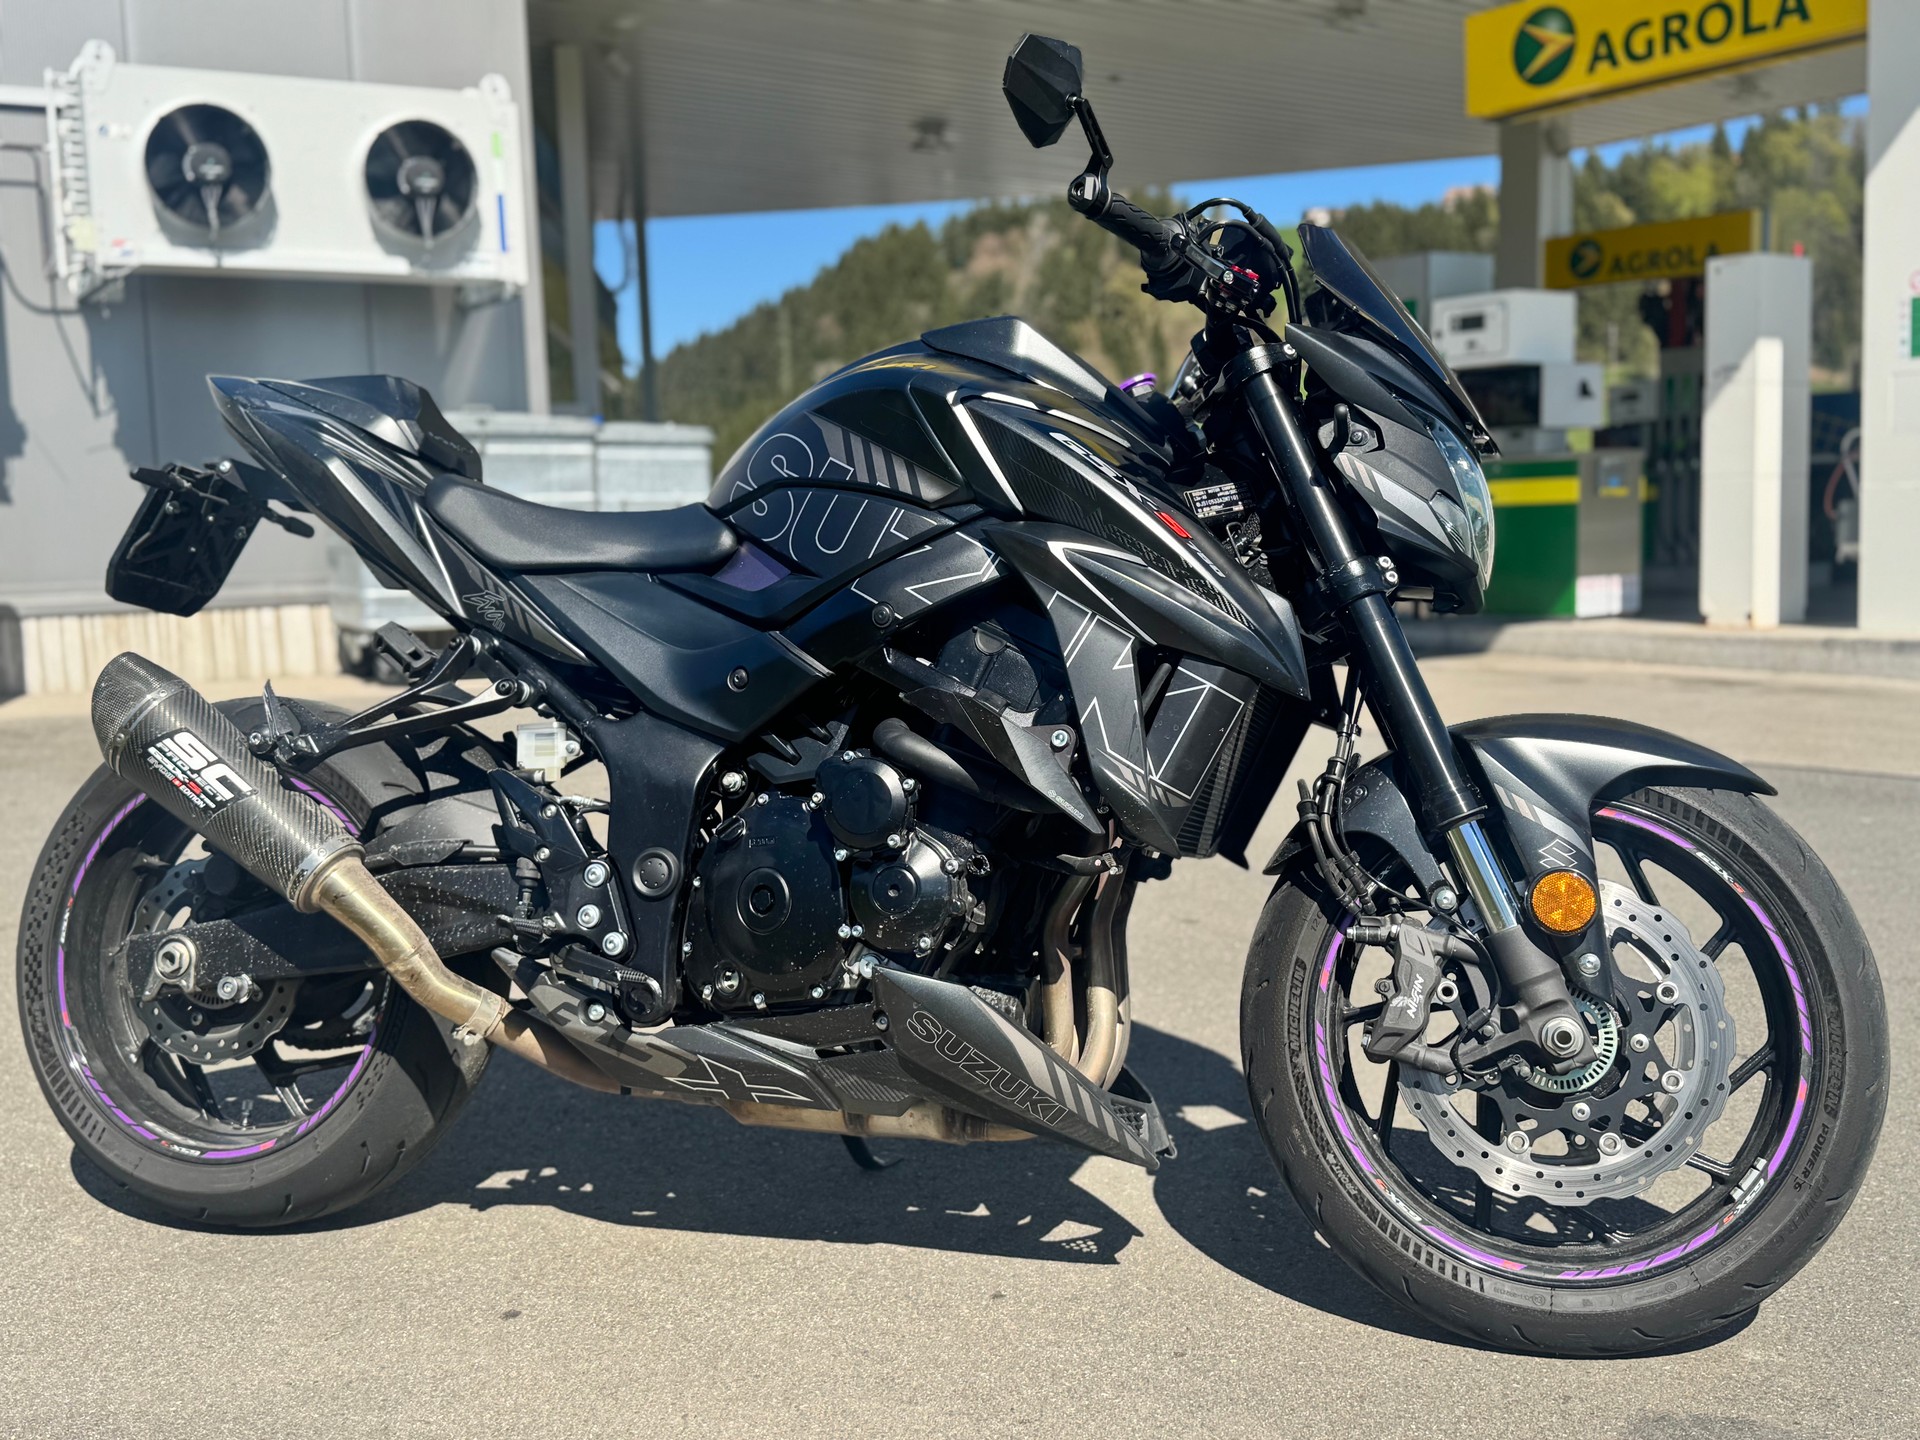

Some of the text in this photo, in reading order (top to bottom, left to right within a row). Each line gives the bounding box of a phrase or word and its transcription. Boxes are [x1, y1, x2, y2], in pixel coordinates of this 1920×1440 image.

[1588, 0, 1811, 74] AGROLA
[1049, 432, 1194, 540] GSX-S
[147, 746, 203, 795] GSX-S
[155, 742, 227, 802] PROJECT
[161, 731, 253, 801] SC
[179, 783, 207, 809] EDITION
[1695, 851, 1745, 889] GSX-S
[1289, 964, 1307, 1051] MICHELIN
[1406, 972, 1425, 1020] NISSIN
[906, 1010, 1069, 1127] SUZUKI
[1825, 1017, 1844, 1112] MICHELIN
[1801, 1122, 1830, 1182] POWER
